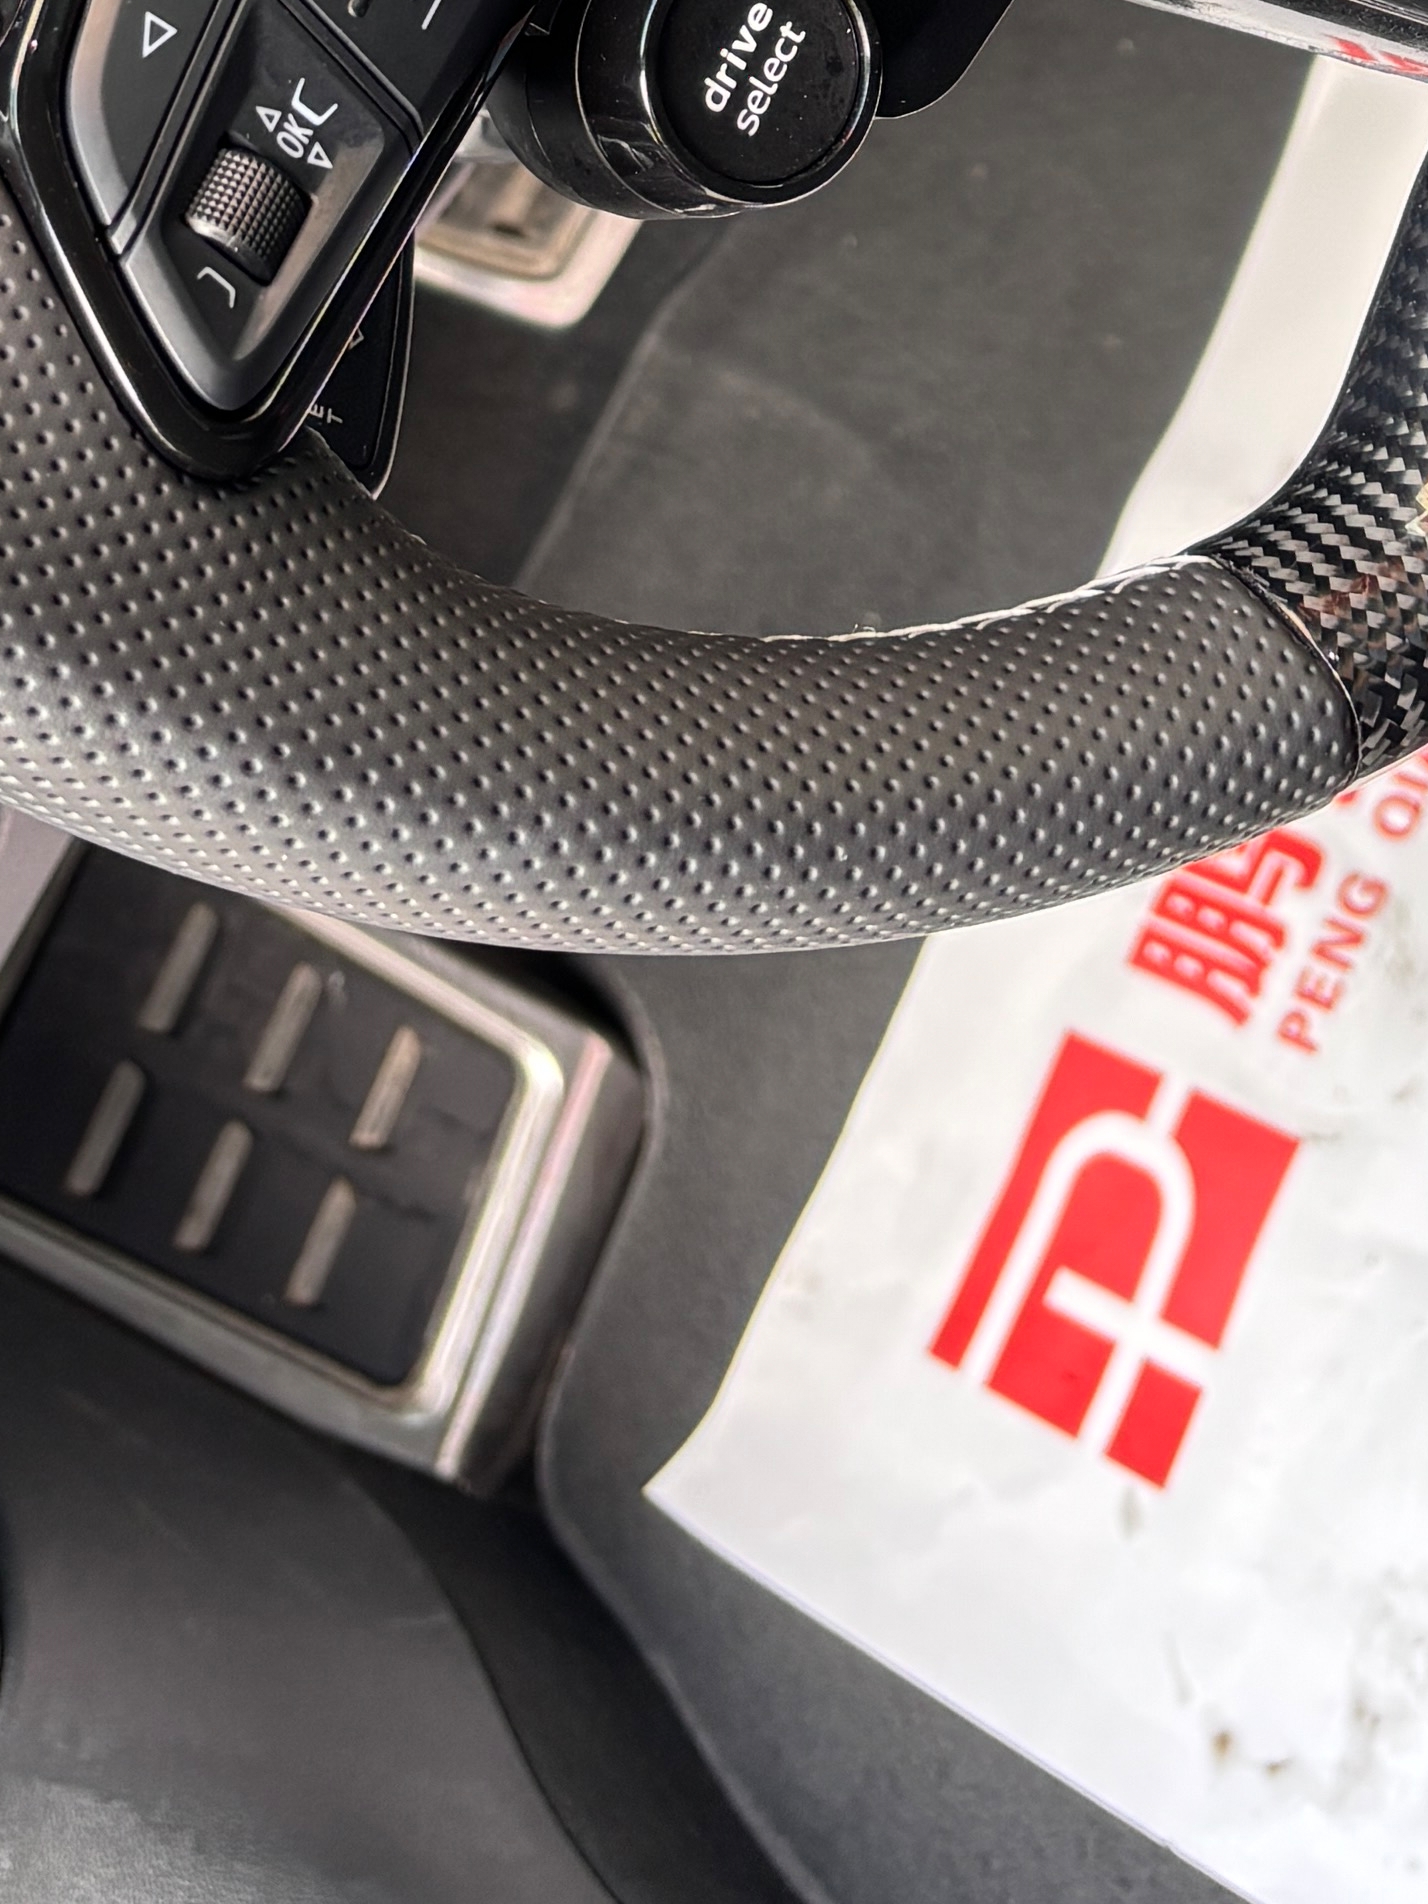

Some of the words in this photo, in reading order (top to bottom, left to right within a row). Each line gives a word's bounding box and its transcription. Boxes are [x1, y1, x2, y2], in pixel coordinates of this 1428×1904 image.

[704, 3, 773, 112] drive
[737, 21, 805, 136] select
[277, 113, 313, 158] OK
[1277, 874, 1387, 1053] PENG
